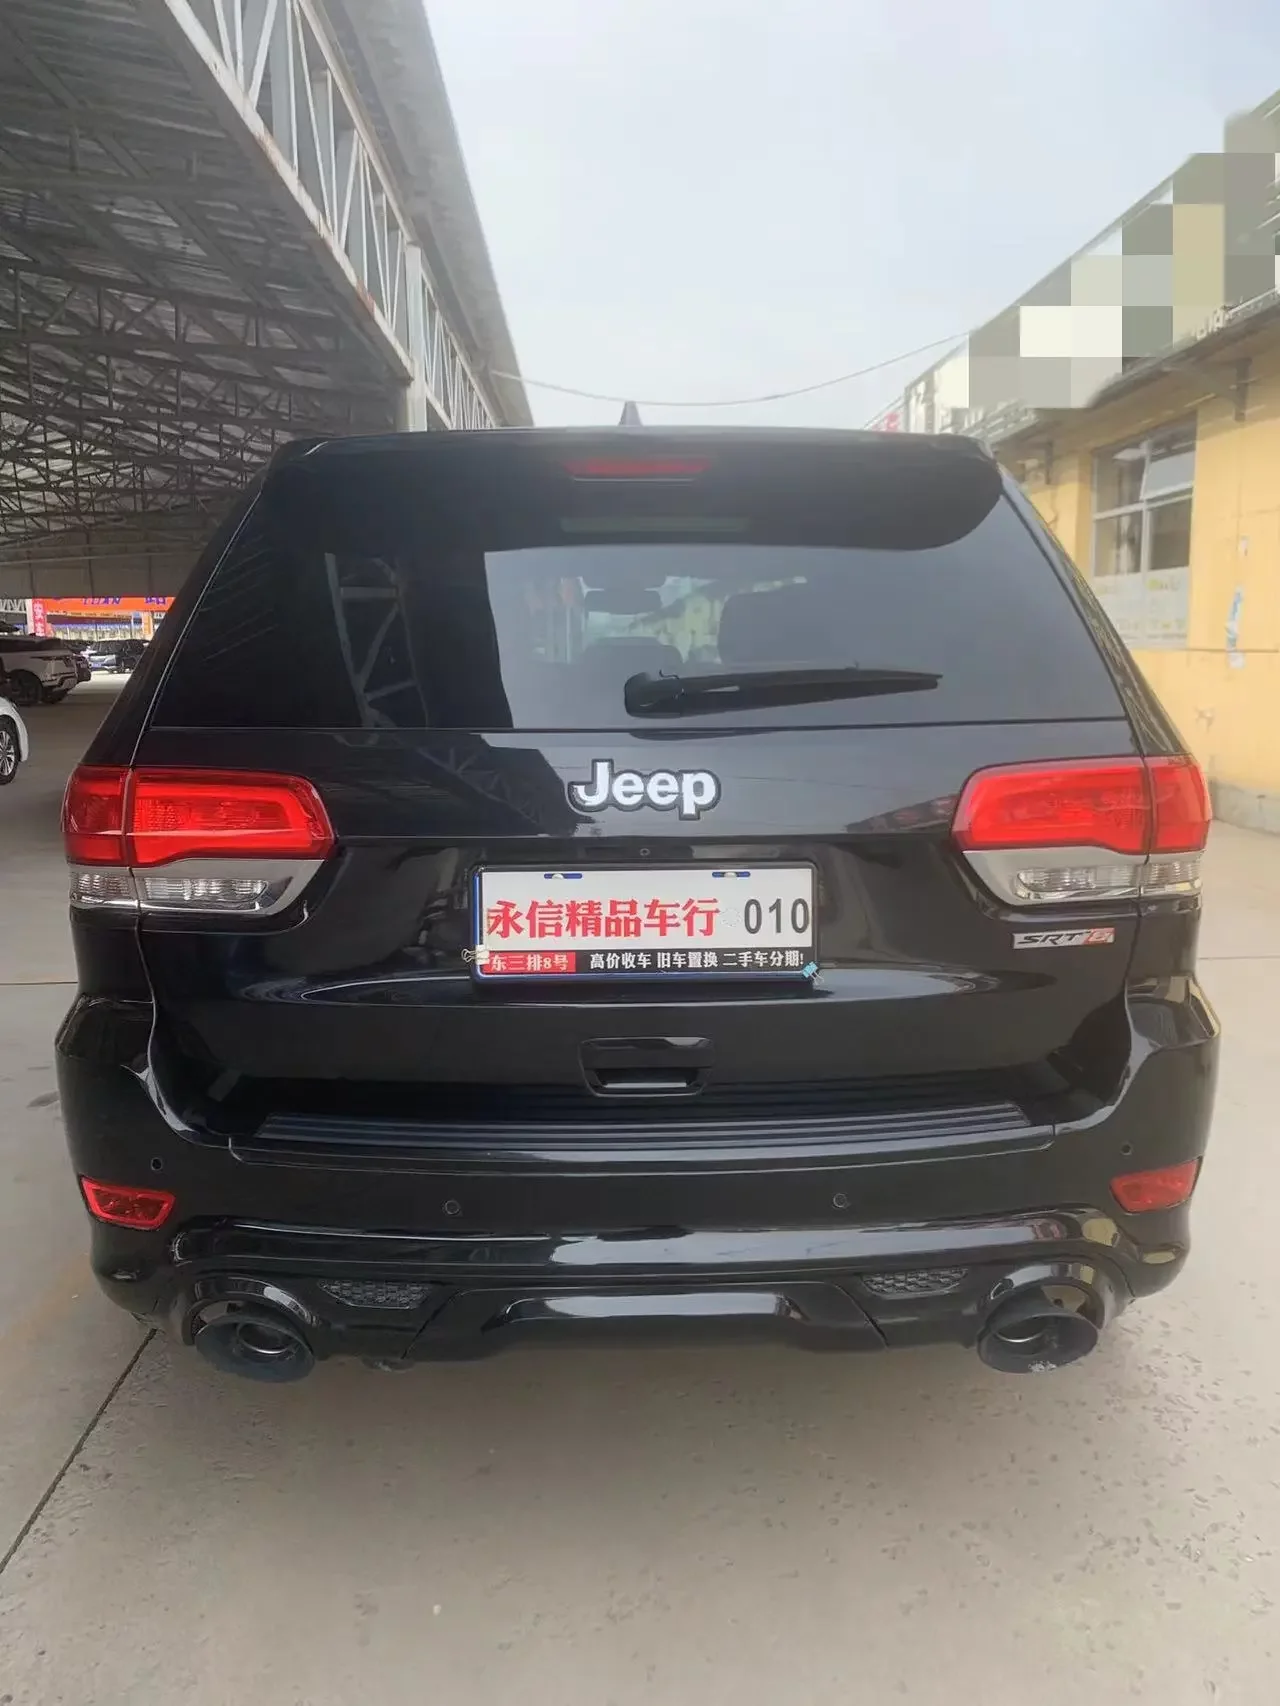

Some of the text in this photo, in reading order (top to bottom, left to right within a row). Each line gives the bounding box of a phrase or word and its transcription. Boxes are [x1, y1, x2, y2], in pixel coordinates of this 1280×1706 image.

[571, 760, 716, 817] Jeep
[486, 899, 809, 938] 永信精品车行 010
[491, 954, 569, 971] 东三排8号
[590, 952, 652, 970] 高价收车
[657, 951, 718, 969] 旧车置换
